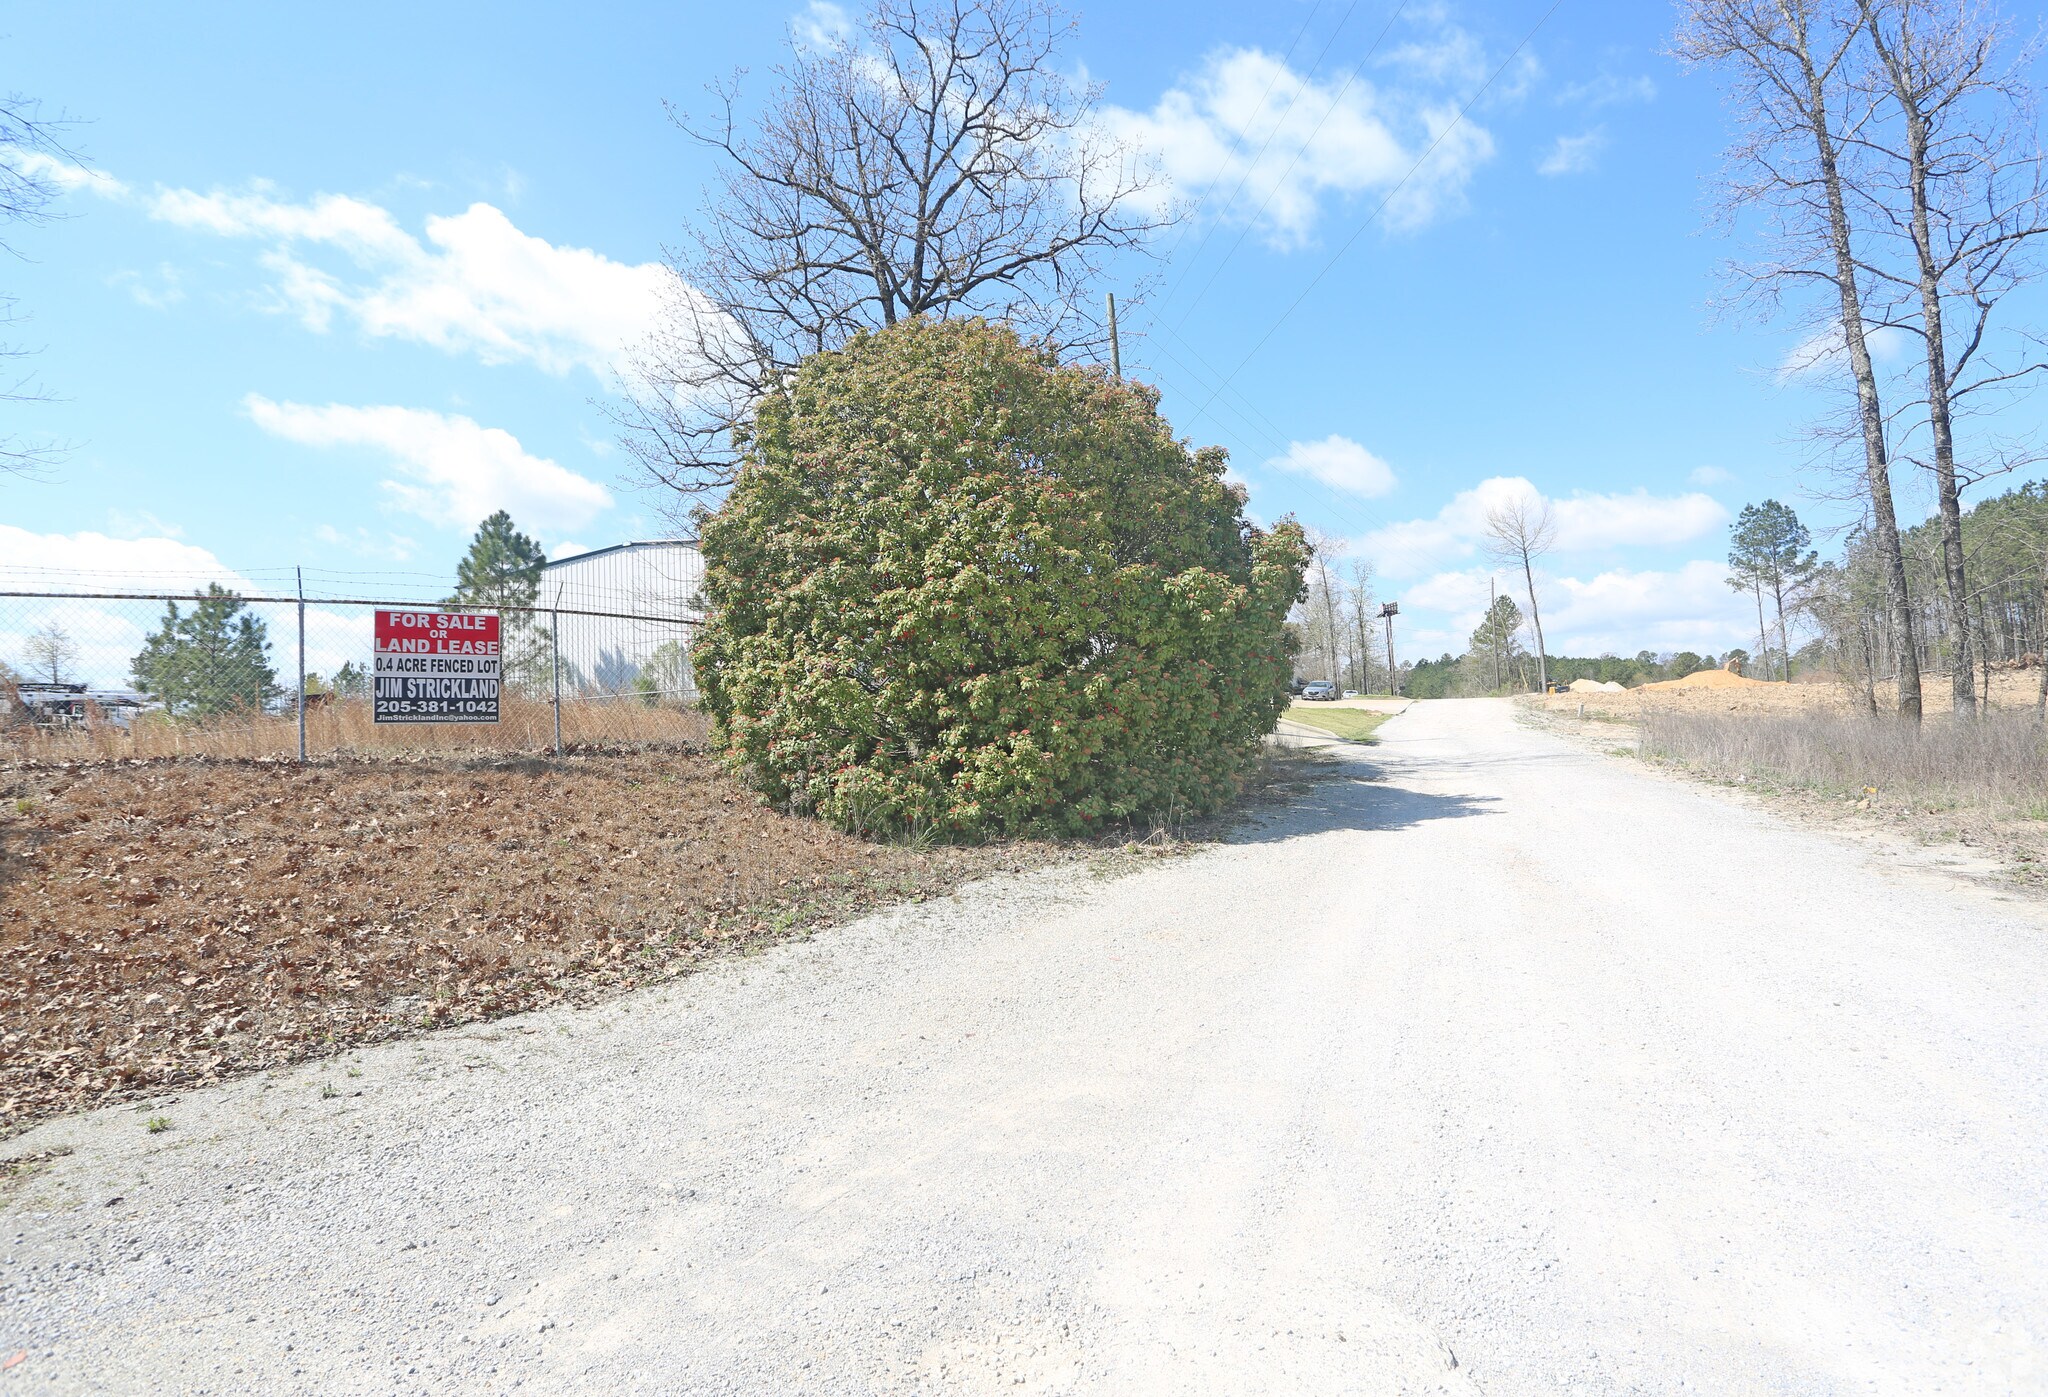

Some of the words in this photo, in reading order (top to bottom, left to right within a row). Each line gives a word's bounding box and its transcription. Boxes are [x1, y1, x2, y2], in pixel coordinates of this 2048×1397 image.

[390, 613, 430, 628] FOR
[437, 615, 485, 630] SALE
[430, 630, 447, 638] OR
[376, 638, 430, 652] LAND
[437, 640, 498, 654] LEASE
[376, 658, 393, 671] 0.4
[397, 658, 426, 672] ACRE
[431, 659, 473, 673] FENCED
[478, 660, 497, 673] LOT
[376, 678, 402, 698] JIM
[407, 679, 498, 698] STRICKLAND
[377, 701, 497, 712] 205-381-1042
